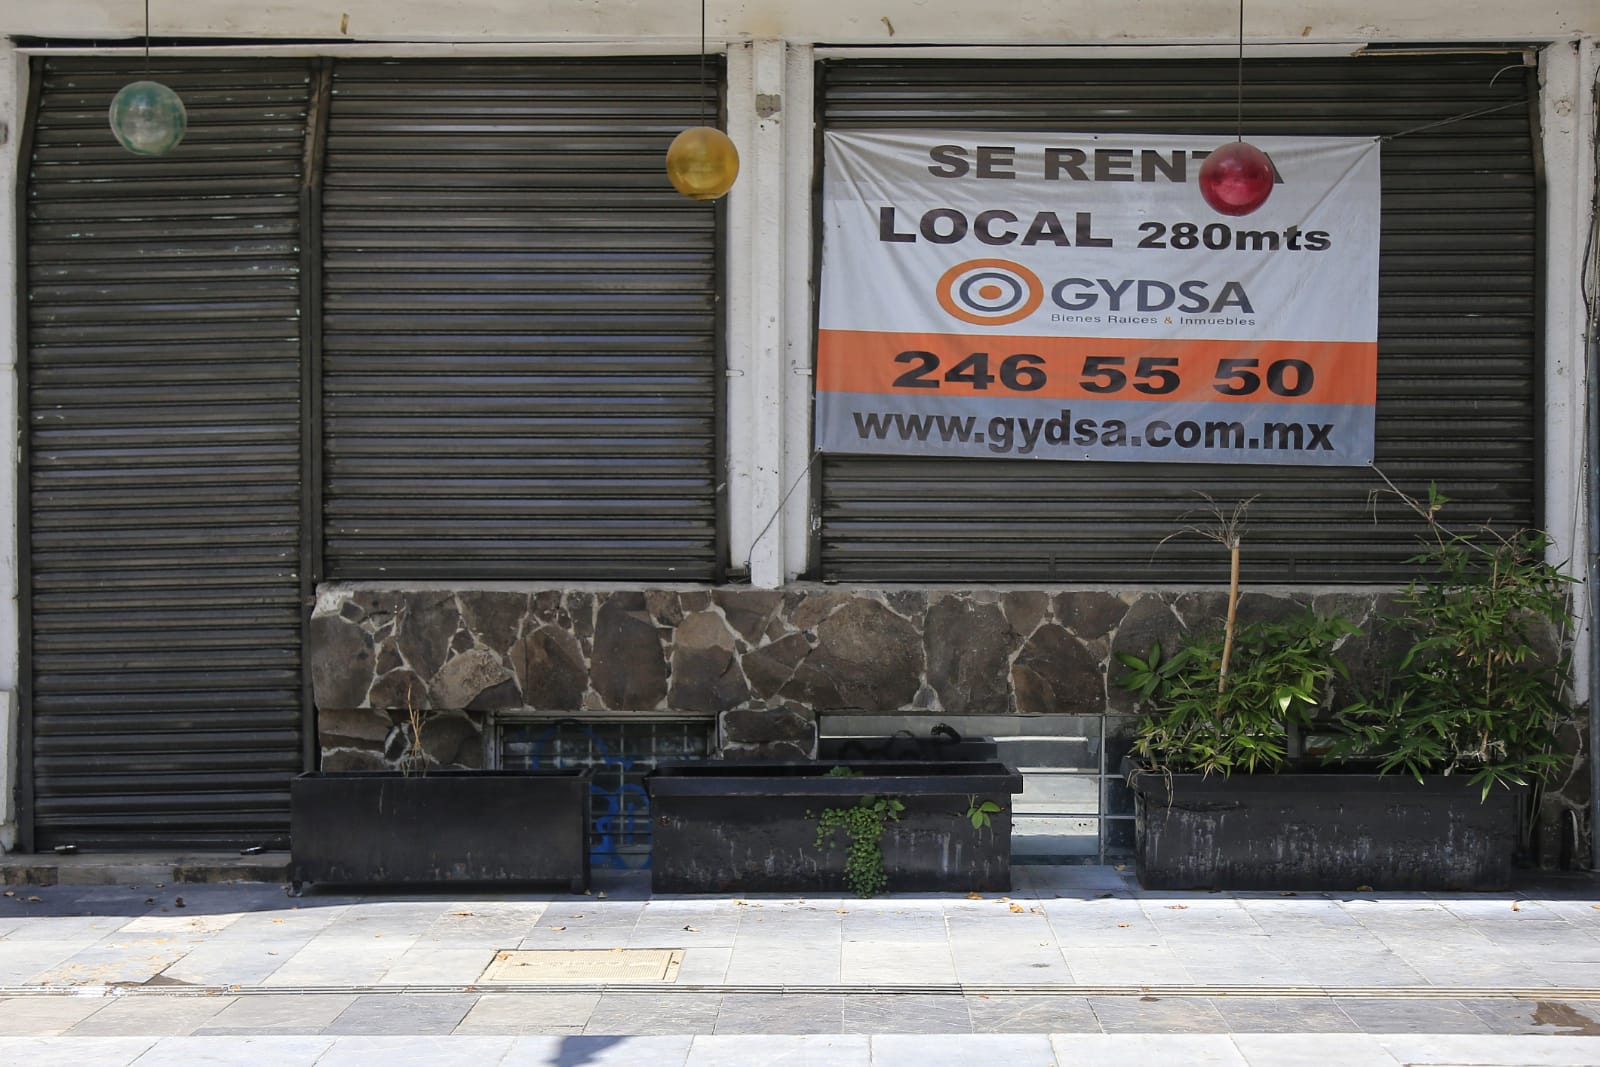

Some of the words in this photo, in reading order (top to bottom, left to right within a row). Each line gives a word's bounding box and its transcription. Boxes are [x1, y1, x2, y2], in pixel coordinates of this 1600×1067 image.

[928, 145, 1016, 179] SE
[1045, 148, 1285, 184] REN
[880, 207, 1112, 248] LOCAL
[1138, 222, 1331, 251] 280mts
[1052, 278, 1255, 313] GYDSA
[1051, 314, 1101, 323] Bienes
[1180, 317, 1256, 326] Inmuebles
[892, 351, 1047, 391] 246
[1079, 356, 1180, 394] 55
[1213, 359, 1315, 397] 50
[853, 409, 1335, 455] www.gydsa.com.mx
